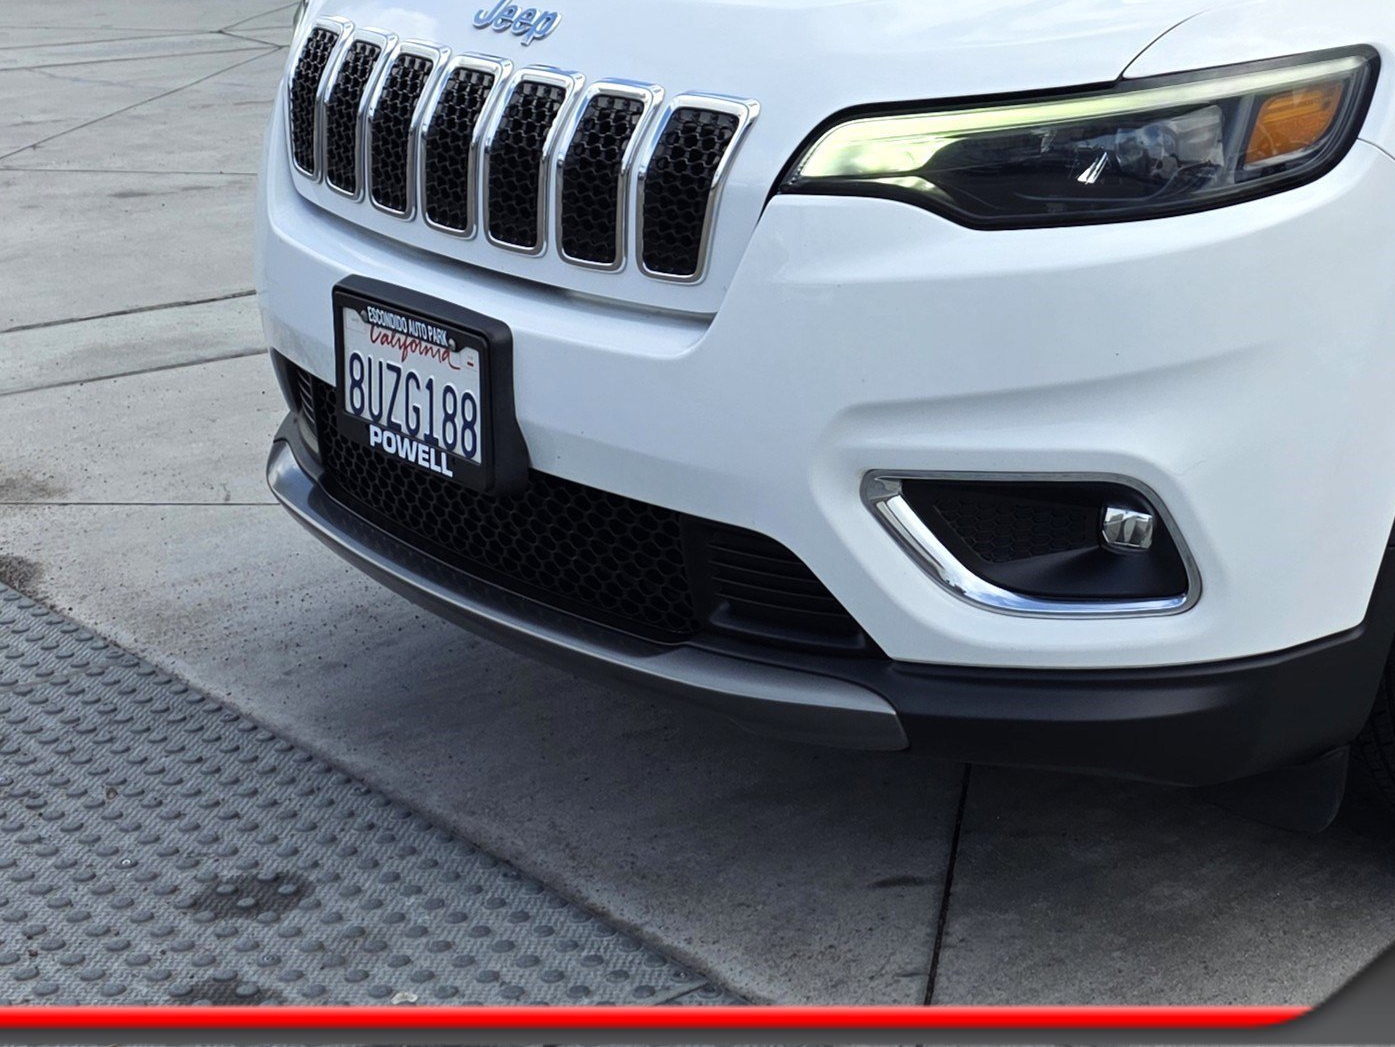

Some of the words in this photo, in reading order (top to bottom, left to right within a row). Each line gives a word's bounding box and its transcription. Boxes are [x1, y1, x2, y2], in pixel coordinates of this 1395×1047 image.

[366, 306, 407, 333] ESCONDIDO
[408, 317, 428, 340] AUTO
[427, 323, 449, 347] PARK
[369, 325, 461, 371] California
[349, 352, 477, 459] 8UZG188
[369, 424, 454, 478] POWELL
